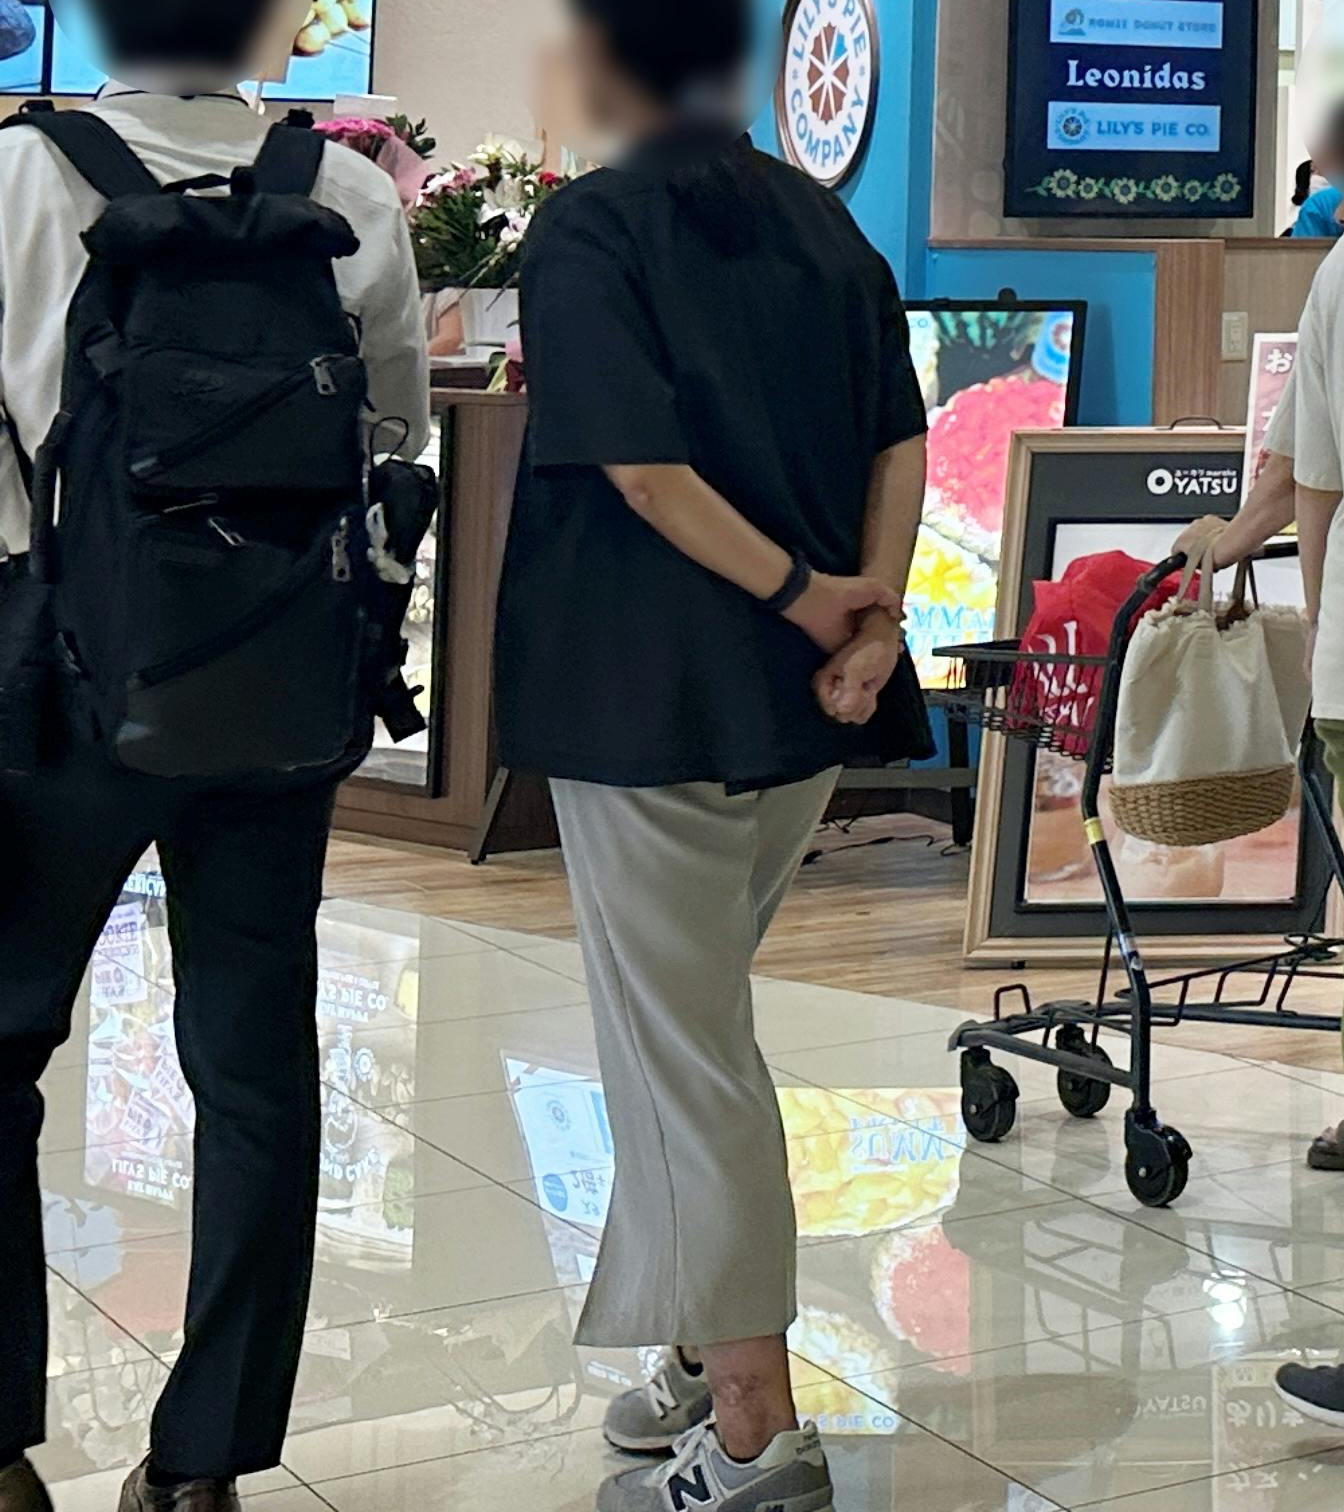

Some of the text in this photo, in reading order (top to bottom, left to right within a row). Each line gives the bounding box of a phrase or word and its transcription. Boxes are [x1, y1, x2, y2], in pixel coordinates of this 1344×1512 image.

[1066, 59, 1207, 90] Leonidas
[790, 86, 865, 170] COMPANY
[1147, 468, 1238, 496] OYATSU
